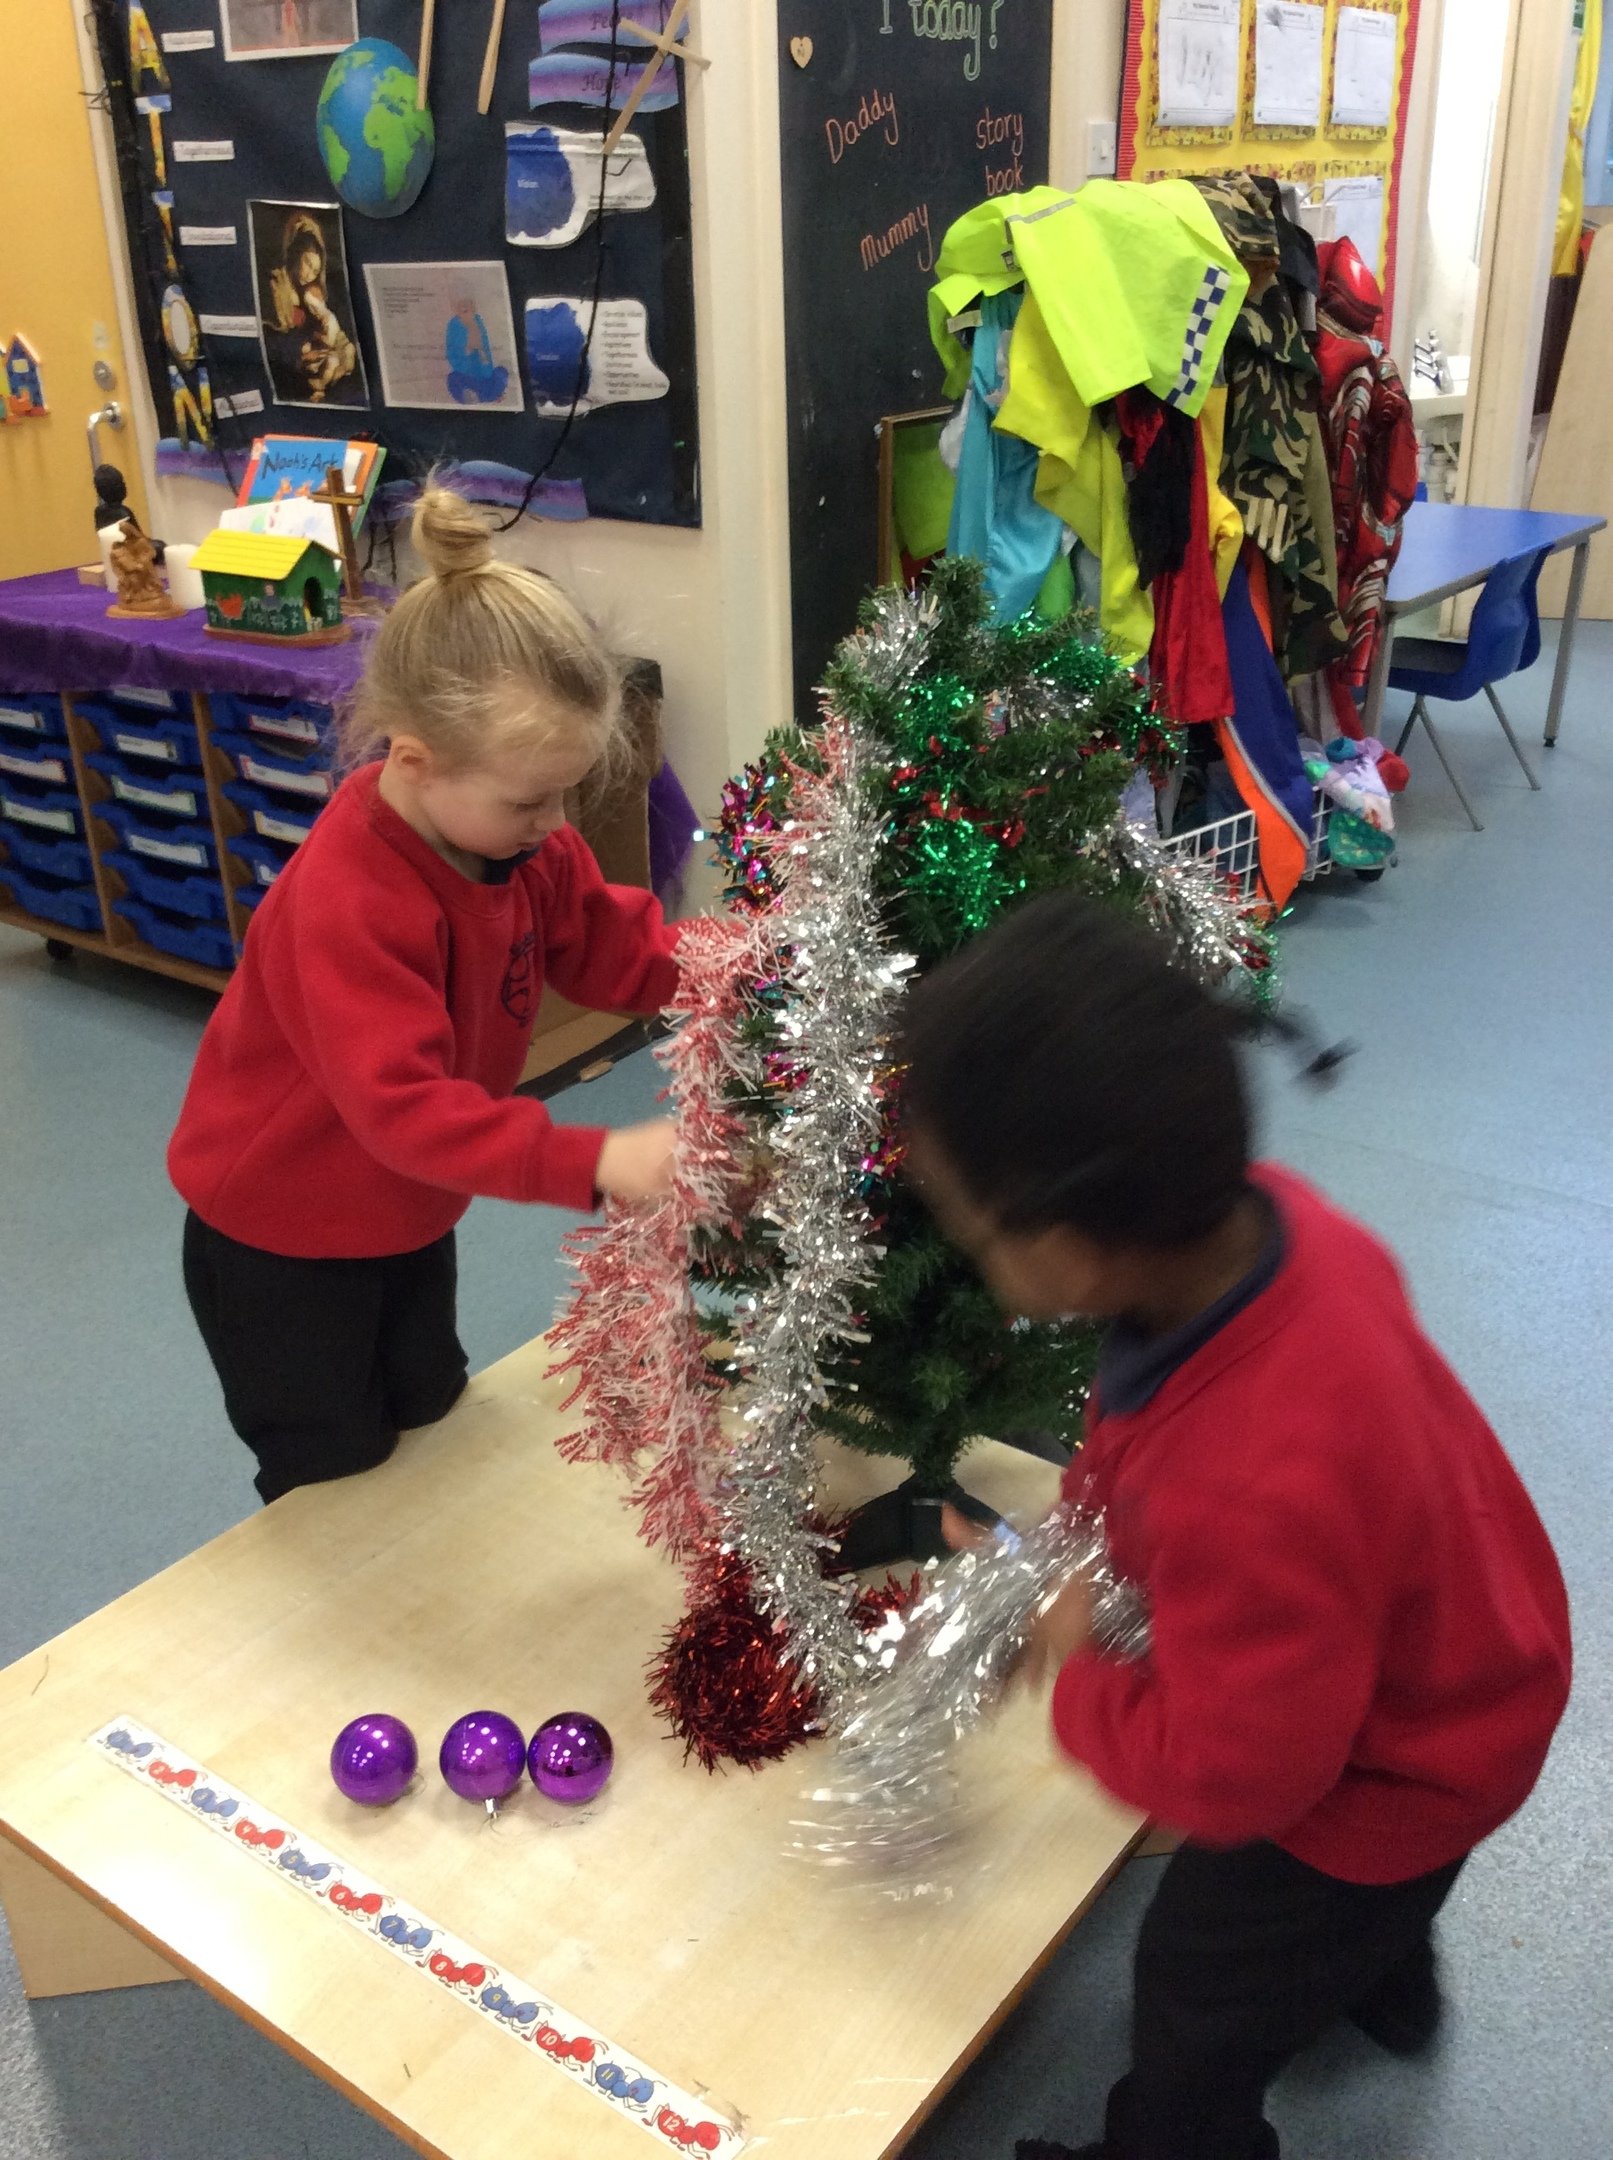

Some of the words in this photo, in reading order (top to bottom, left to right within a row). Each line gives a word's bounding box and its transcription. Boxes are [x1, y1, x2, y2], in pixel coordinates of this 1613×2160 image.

[825, 88, 900, 165] Daddy
[975, 106, 1025, 157] story
[985, 157, 1025, 197] book
[289, 1854, 299, 1865] 5
[335, 1890, 346, 1901] 6
[387, 1919, 399, 1931] 7
[436, 1961, 448, 1972] 8
[493, 1993, 503, 2003] 9
[541, 2031, 558, 2046] 10
[601, 2068, 615, 2081] 11
[663, 2115, 681, 2132] 12
